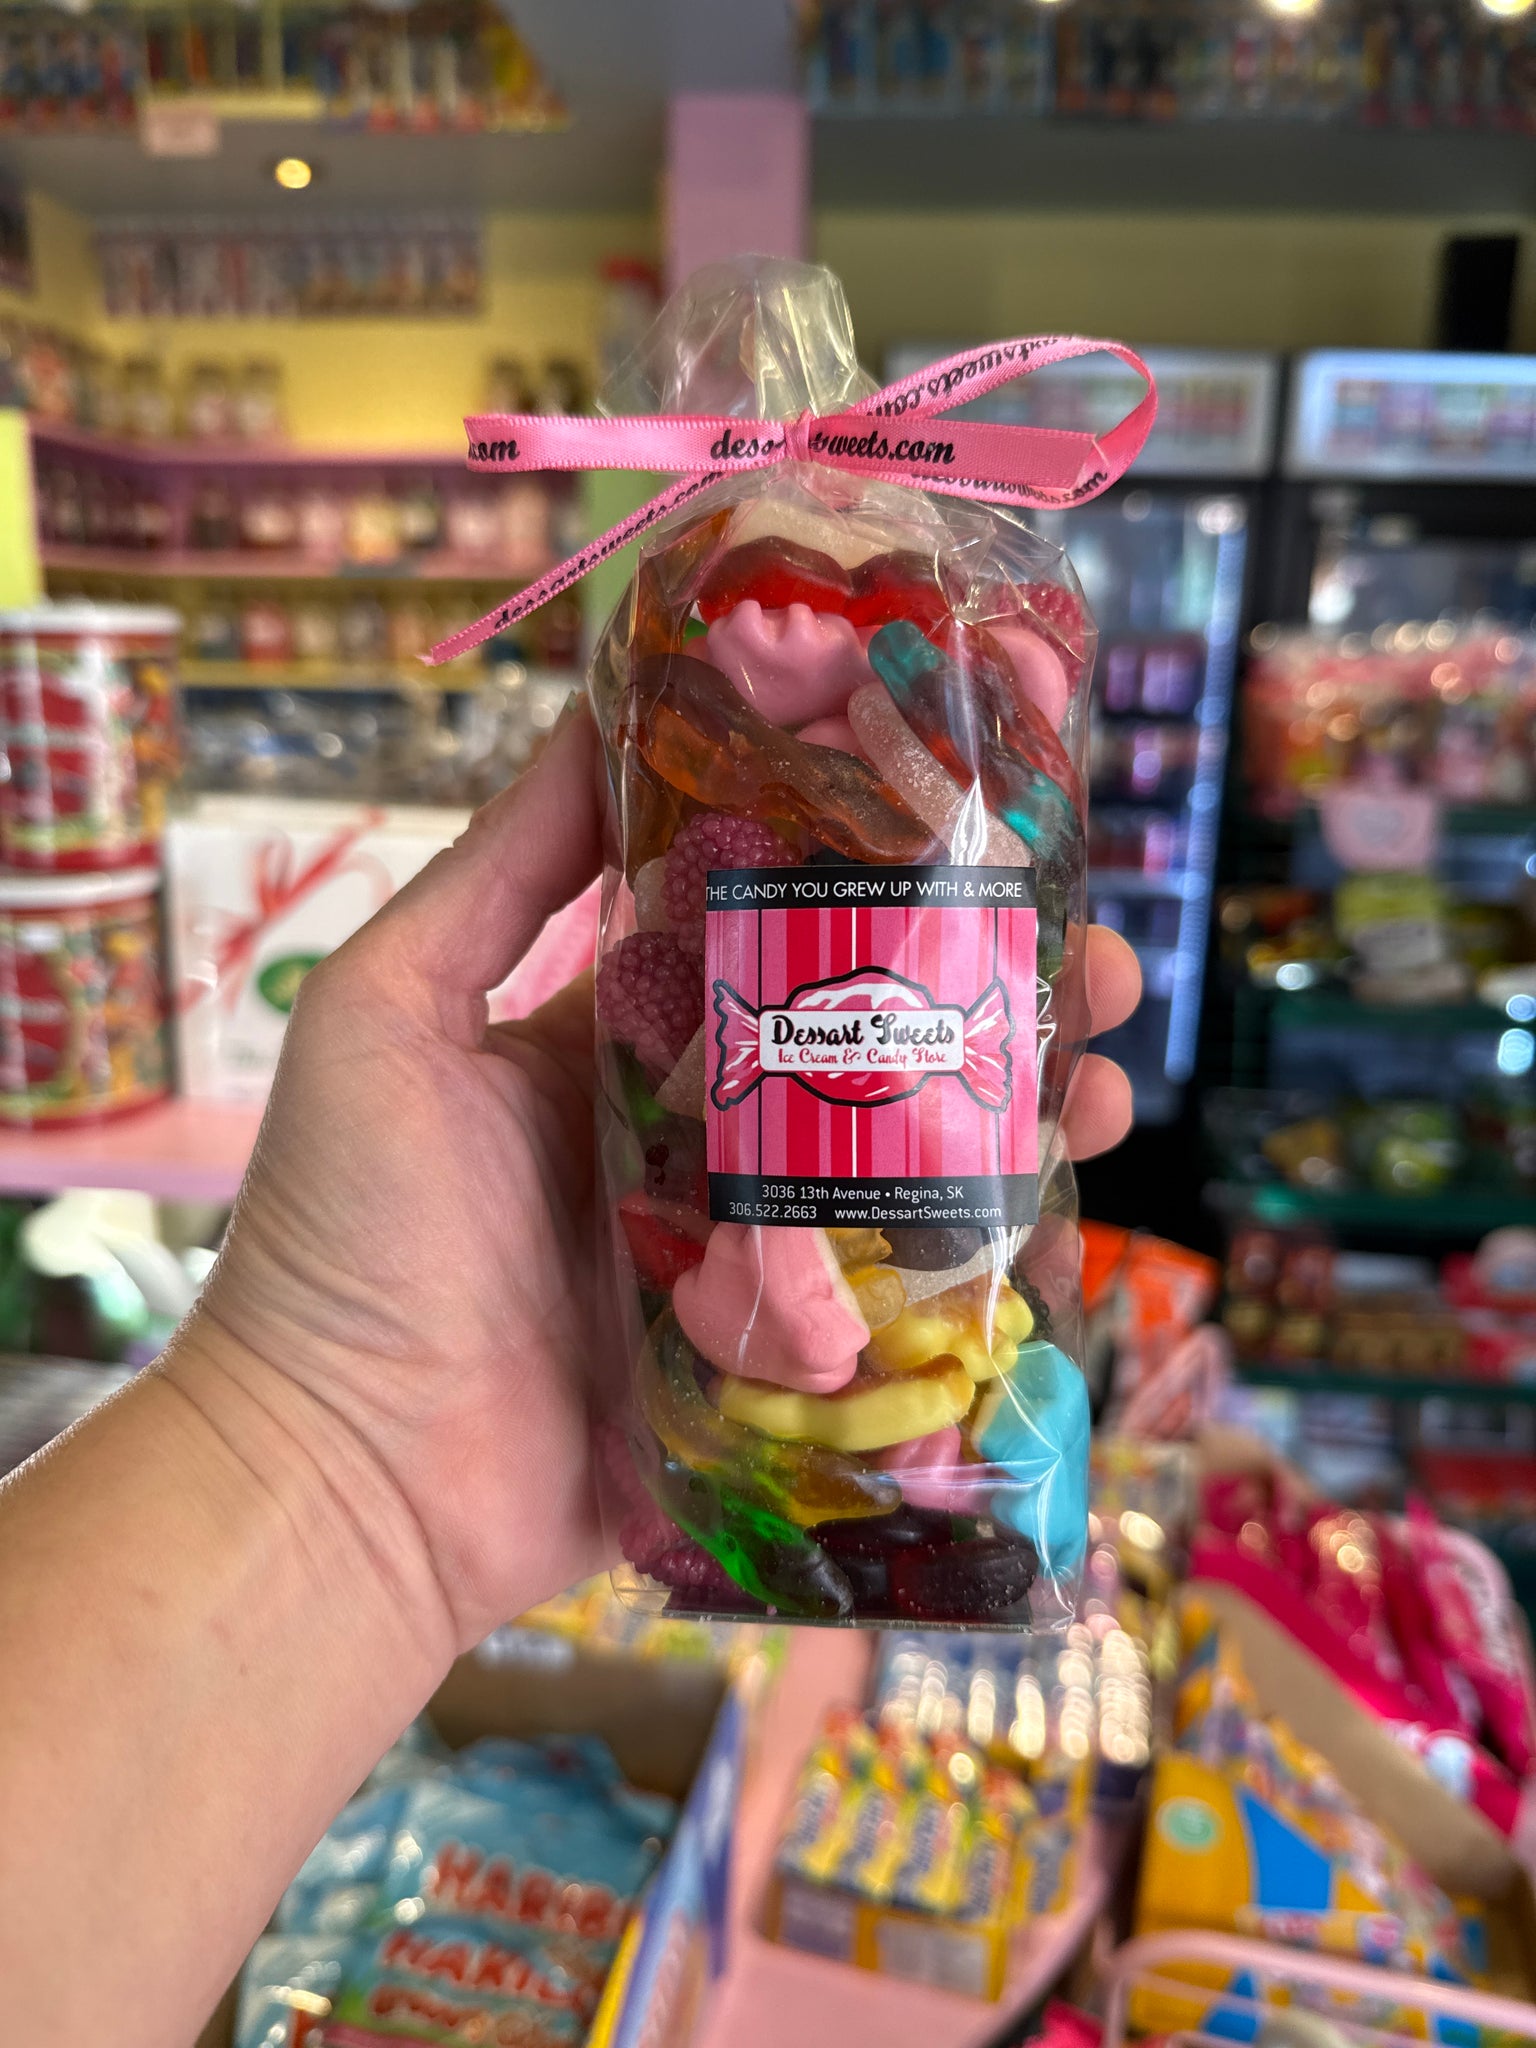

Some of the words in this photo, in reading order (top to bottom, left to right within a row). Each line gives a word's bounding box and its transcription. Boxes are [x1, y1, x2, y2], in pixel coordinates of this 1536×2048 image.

[732, 882, 787, 901] CANDY
[792, 881, 828, 899] YOU
[833, 881, 886, 898] GREW
[890, 880, 912, 897] UP
[916, 880, 958, 897] WITH
[963, 881, 975, 898] &
[978, 881, 1022, 898] MORE
[771, 1014, 864, 1046] Dessart
[870, 1012, 956, 1046] Sweets
[778, 1048, 794, 1064] Ice
[799, 1048, 838, 1065] Cream
[842, 1048, 860, 1065] &
[866, 1048, 907, 1069] Candy
[911, 1046, 947, 1064] Store
[761, 1184, 795, 1199] 3036
[800, 1185, 829, 1200] 13th
[832, 1187, 881, 1200] Avenue
[894, 1186, 944, 1202] Regina,
[946, 1185, 964, 1199] SK
[728, 1201, 817, 1220] 306.522.2663
[834, 1205, 1002, 1220] www.DessartSweets.com
